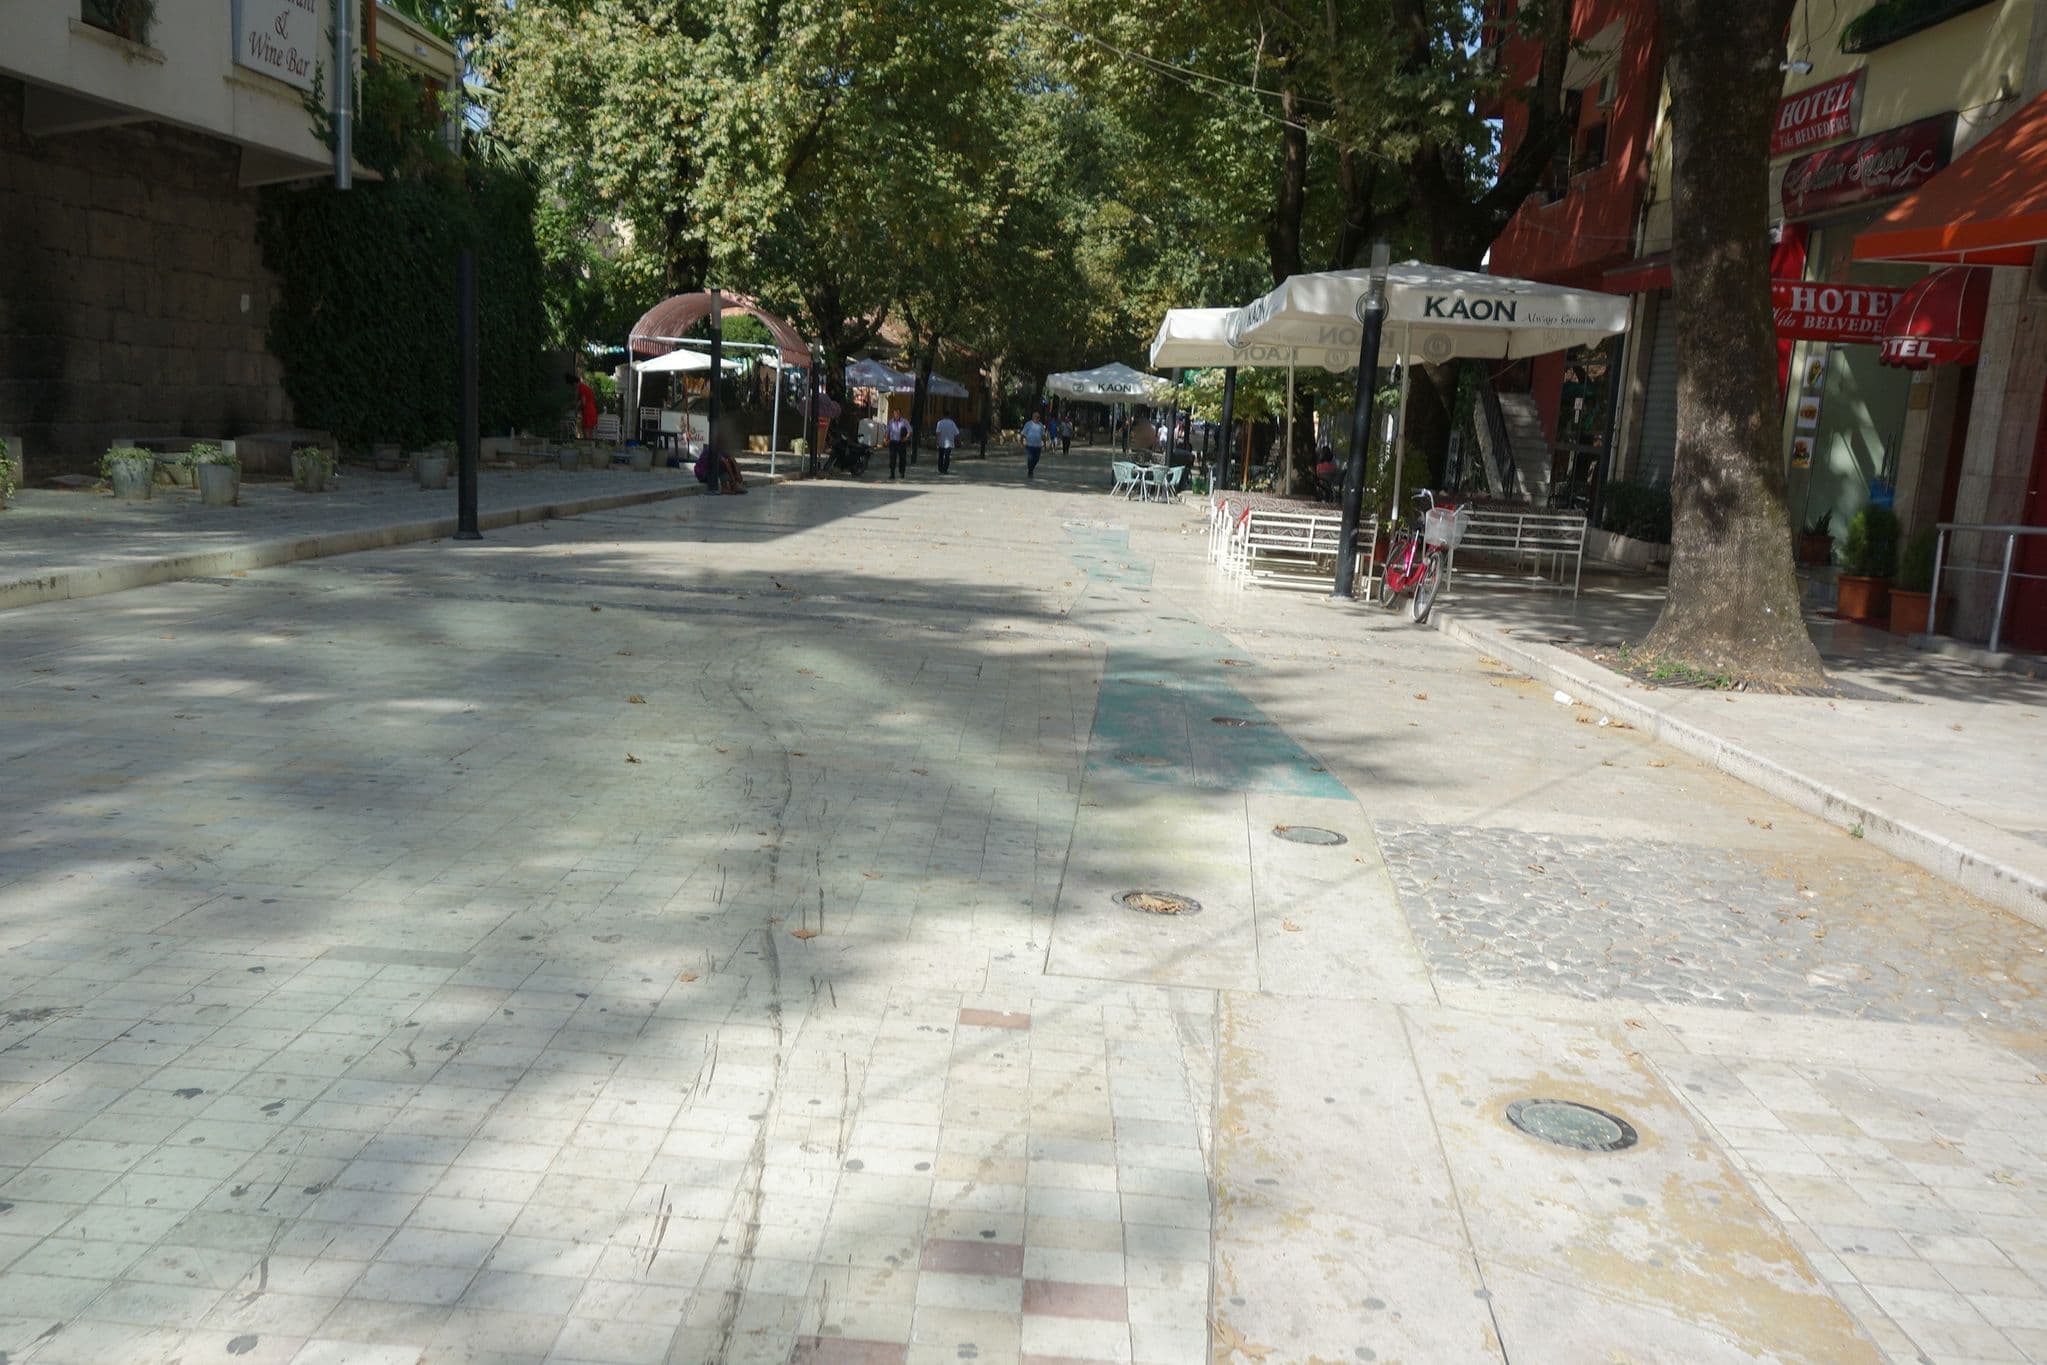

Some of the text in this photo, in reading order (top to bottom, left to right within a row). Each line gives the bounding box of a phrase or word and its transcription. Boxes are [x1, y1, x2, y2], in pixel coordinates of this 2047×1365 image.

[274, 9, 290, 40] &
[248, 31, 310, 77] Wine Bar
[1778, 81, 1850, 131] HOTEL
[1795, 114, 1850, 145] BELVEDERE
[1424, 296, 1517, 322] KAON
[1804, 315, 1882, 333] BELVEDE
[1097, 383, 1132, 393] KAON
